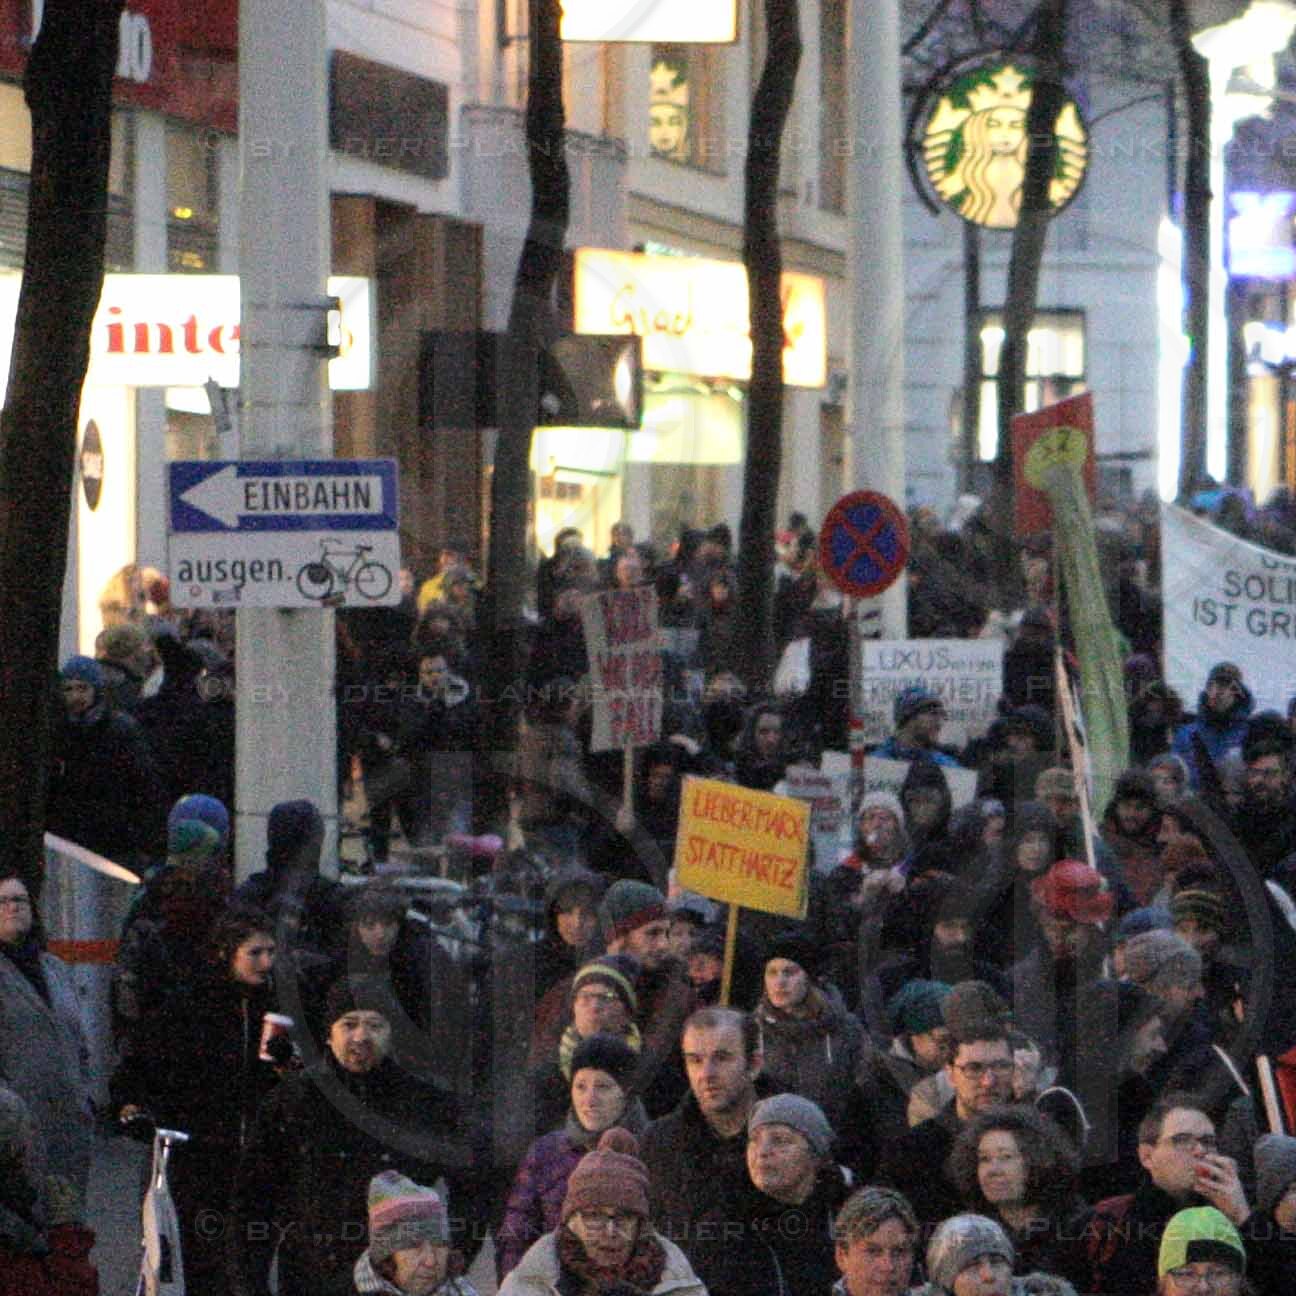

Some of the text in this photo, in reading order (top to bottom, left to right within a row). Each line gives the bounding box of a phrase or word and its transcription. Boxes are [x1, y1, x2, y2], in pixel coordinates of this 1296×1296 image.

[244, 481, 371, 511] EINBAHN
[178, 559, 293, 589] ausgen.
[1193, 597, 1238, 631] IST
